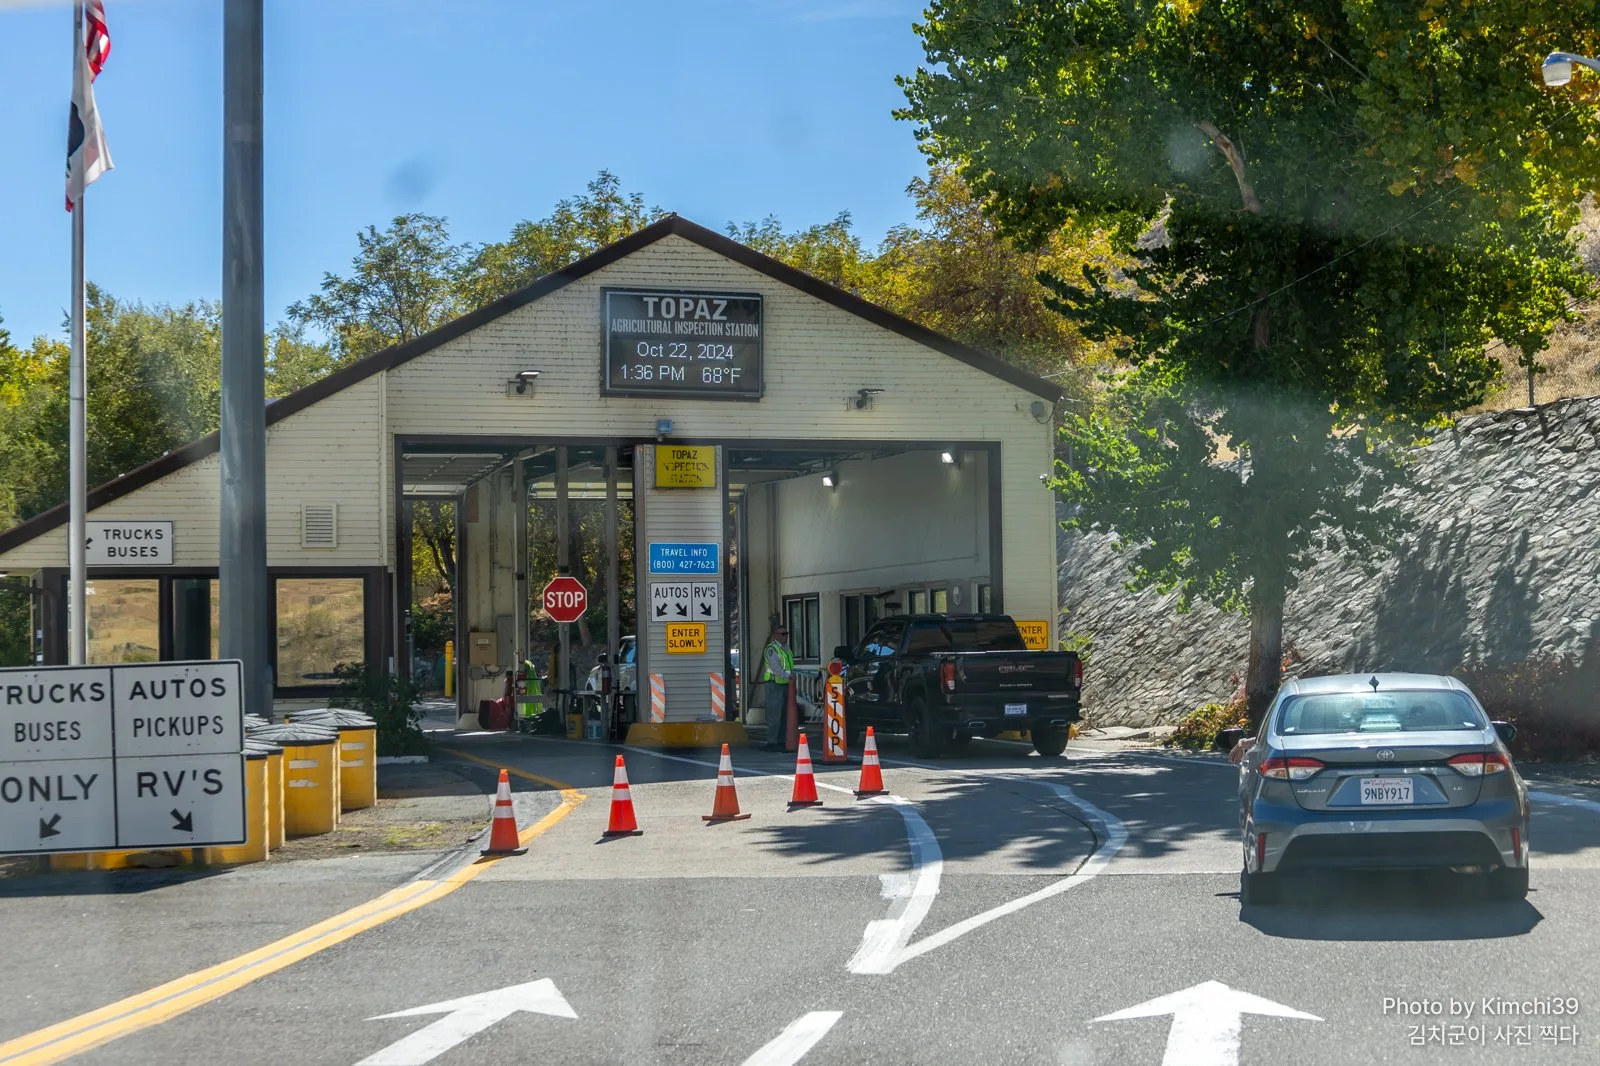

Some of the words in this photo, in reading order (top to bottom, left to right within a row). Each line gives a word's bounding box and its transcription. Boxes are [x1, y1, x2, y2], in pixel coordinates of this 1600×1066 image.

[643, 297, 728, 321] TOPAZ
[611, 318, 672, 334] AGRICULTURAL
[675, 321, 723, 337] INSPECTION
[725, 323, 759, 338] STATION
[637, 341, 664, 357] Oct
[668, 343, 693, 361] 22,
[697, 344, 734, 360] 2024
[621, 364, 653, 380] 1:36
[659, 366, 685, 381] PM
[702, 367, 742, 384] 68°F
[671, 450, 698, 460] TOPAZ
[103, 528, 164, 540] TRUCKS
[107, 546, 159, 557] BUSES
[661, 548, 687, 557] TRAVEL
[691, 548, 708, 557] INFO
[653, 560, 675, 569] (800)
[679, 560, 715, 569] 427-7623
[546, 591, 584, 608] STOP
[654, 586, 689, 599] AUTOS
[694, 586, 716, 598] RV'S
[672, 628, 700, 637] ENTER
[1019, 625, 1043, 635] NTER
[668, 639, 704, 648] SLOWLY
[1023, 636, 1046, 645] OWLY
[0, 682, 105, 705] RUCKS
[129, 678, 226, 700] AUTOS
[133, 715, 224, 738] PICKUPS
[831, 686, 840, 753] STOP
[15, 721, 81, 742] BUSES
[1, 773, 99, 803] ONLY
[136, 769, 224, 798] RV'S
[1364, 787, 1410, 800] 9NBY917
